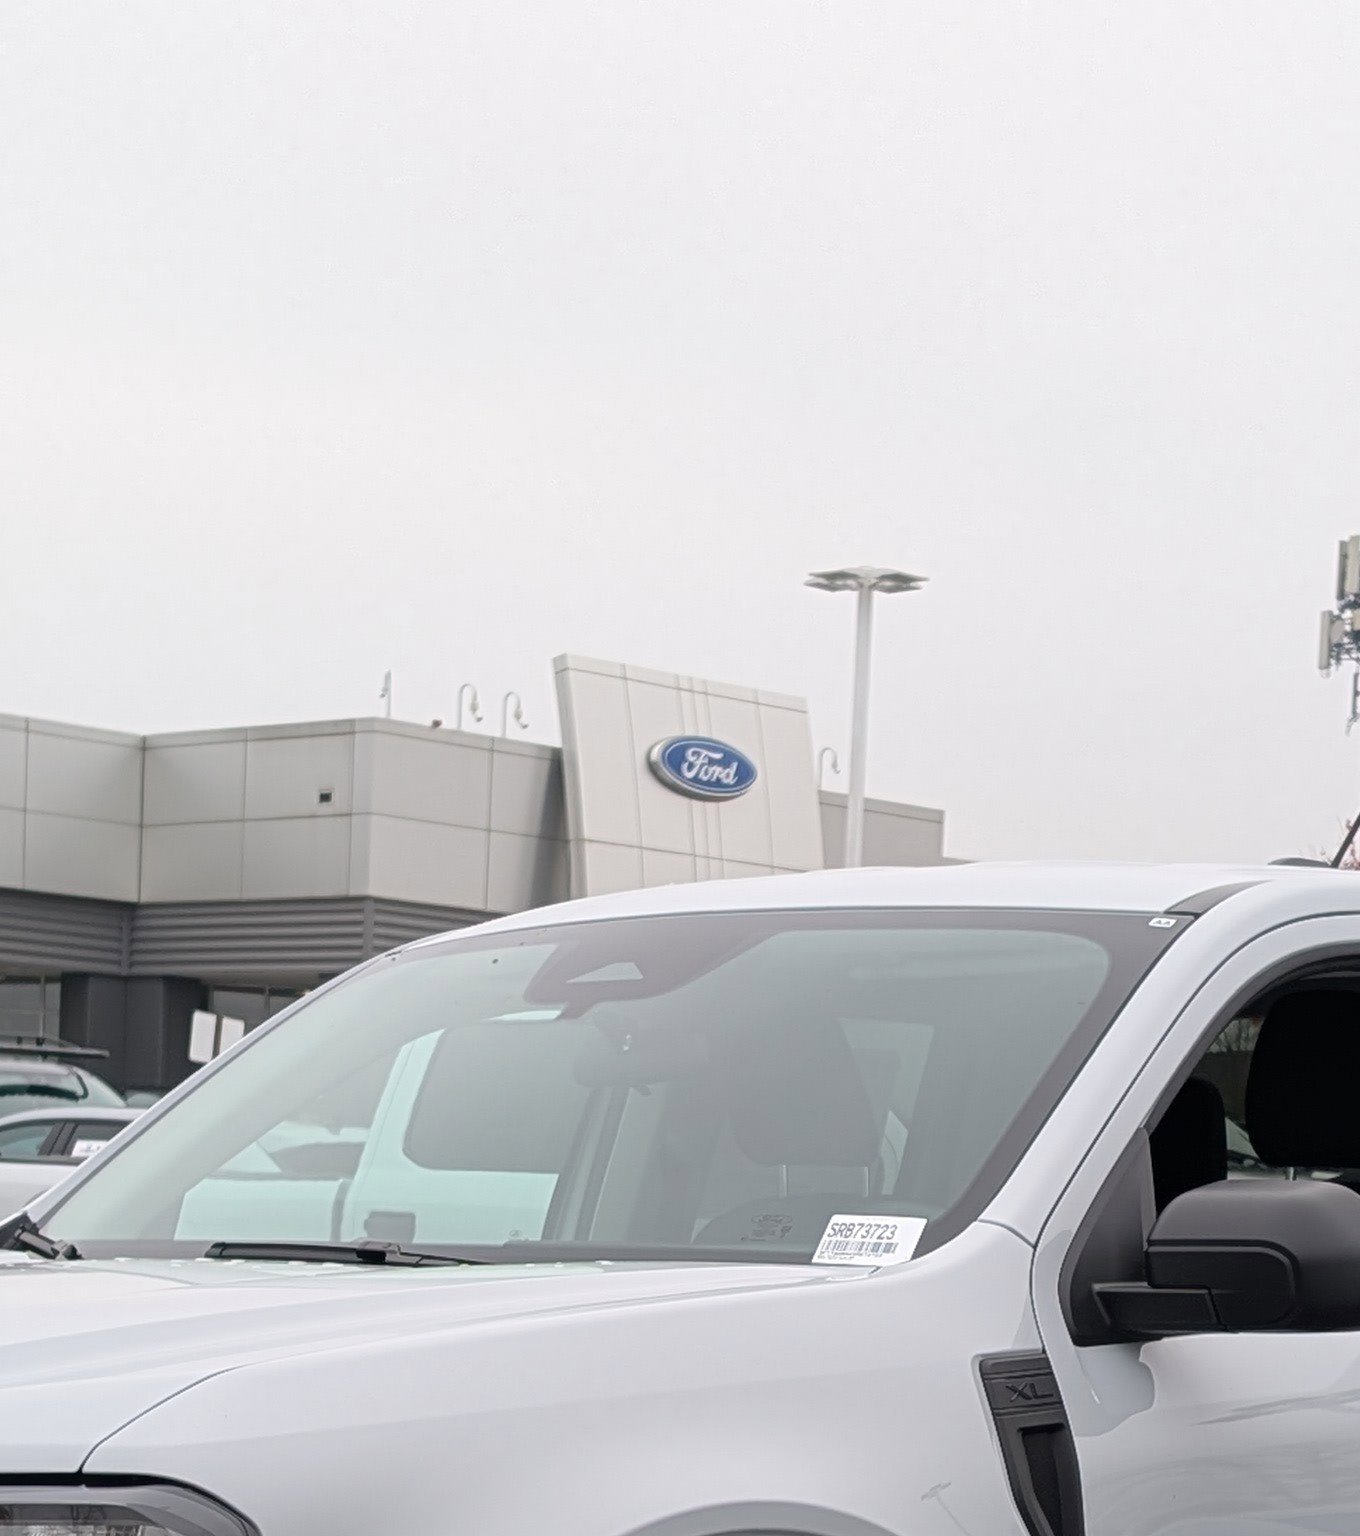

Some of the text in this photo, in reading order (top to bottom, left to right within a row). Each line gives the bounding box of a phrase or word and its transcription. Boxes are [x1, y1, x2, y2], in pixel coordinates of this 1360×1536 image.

[680, 747, 739, 785] Ford
[827, 1222, 898, 1240] SRB73723
[1005, 1382, 1054, 1402] XL
